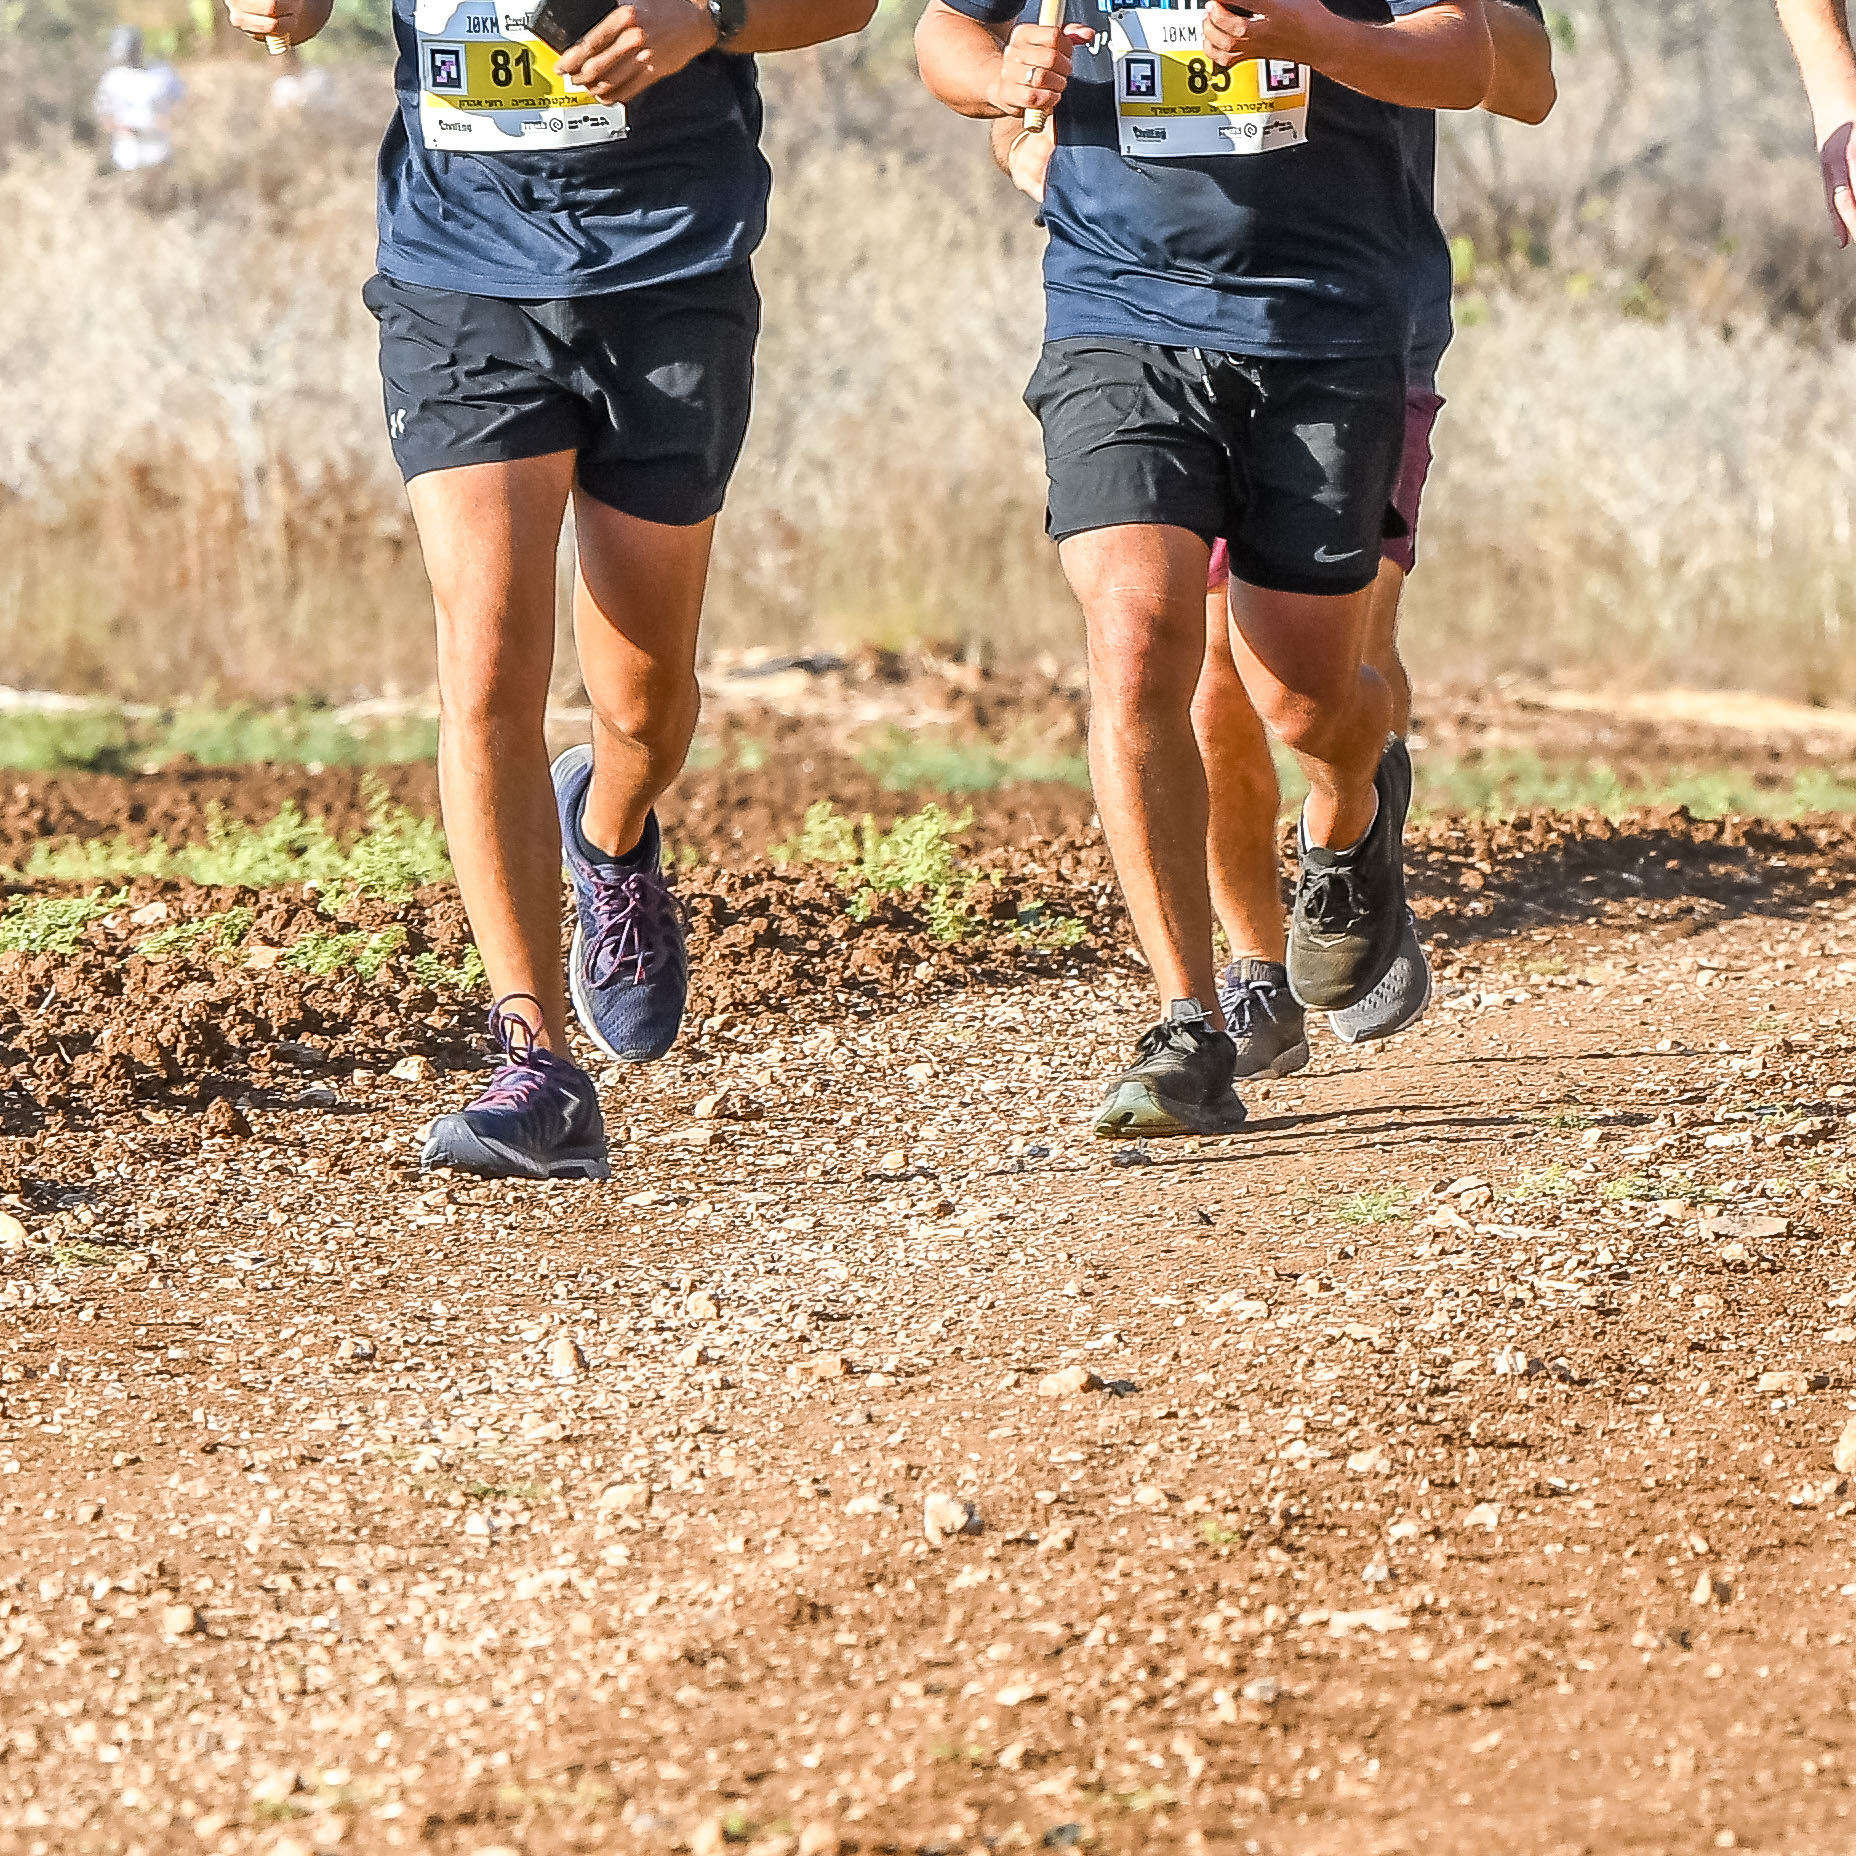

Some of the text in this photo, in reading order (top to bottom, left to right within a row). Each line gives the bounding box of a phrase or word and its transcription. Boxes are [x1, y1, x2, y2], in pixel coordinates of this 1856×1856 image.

[465, 15, 500, 34] 10KM
[1162, 26, 1197, 43] 10KM
[490, 48, 534, 88] 81
[1187, 57, 1231, 94] 85
